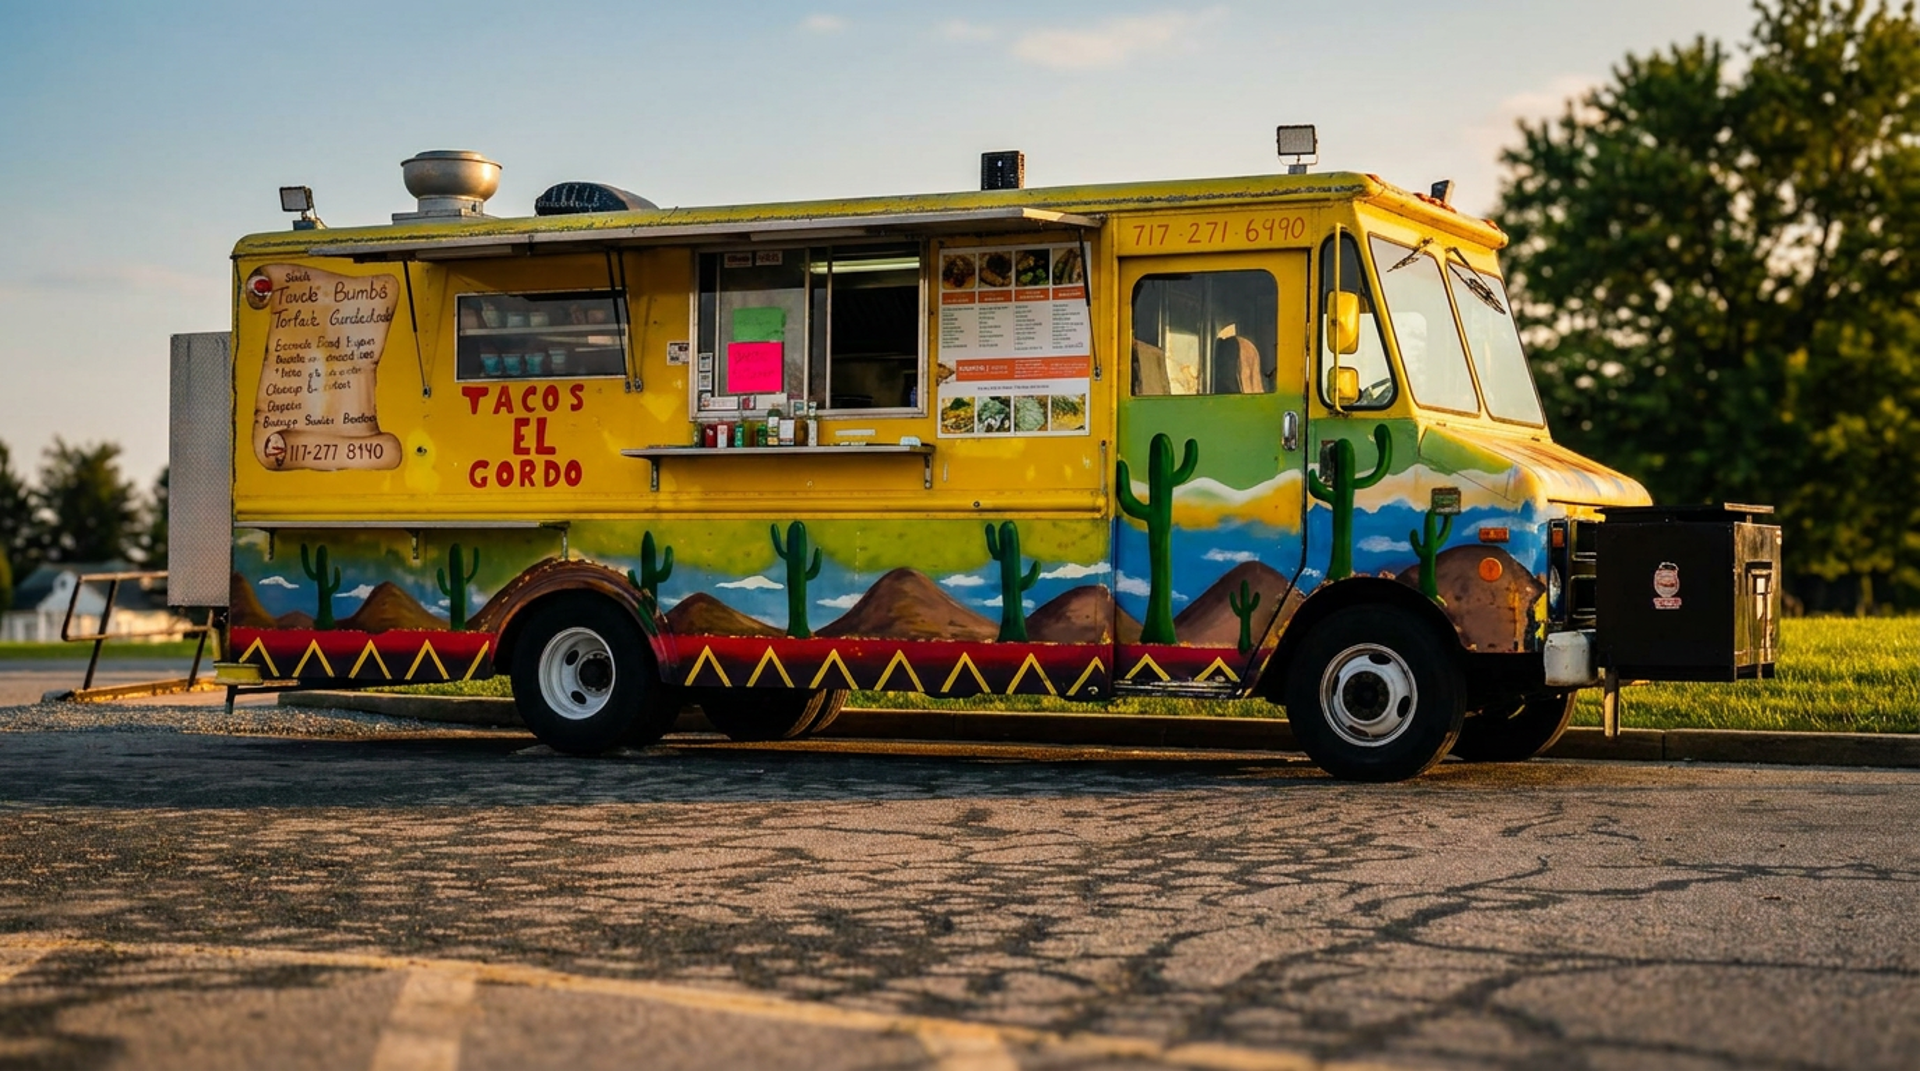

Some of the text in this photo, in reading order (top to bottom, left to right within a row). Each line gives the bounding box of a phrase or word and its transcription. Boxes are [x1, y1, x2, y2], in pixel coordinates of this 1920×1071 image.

[1133, 224, 1170, 246] 717
[1187, 221, 1228, 244] 271
[461, 383, 585, 415] TACOS
[513, 417, 556, 455] EL
[469, 459, 582, 488] GORDO
